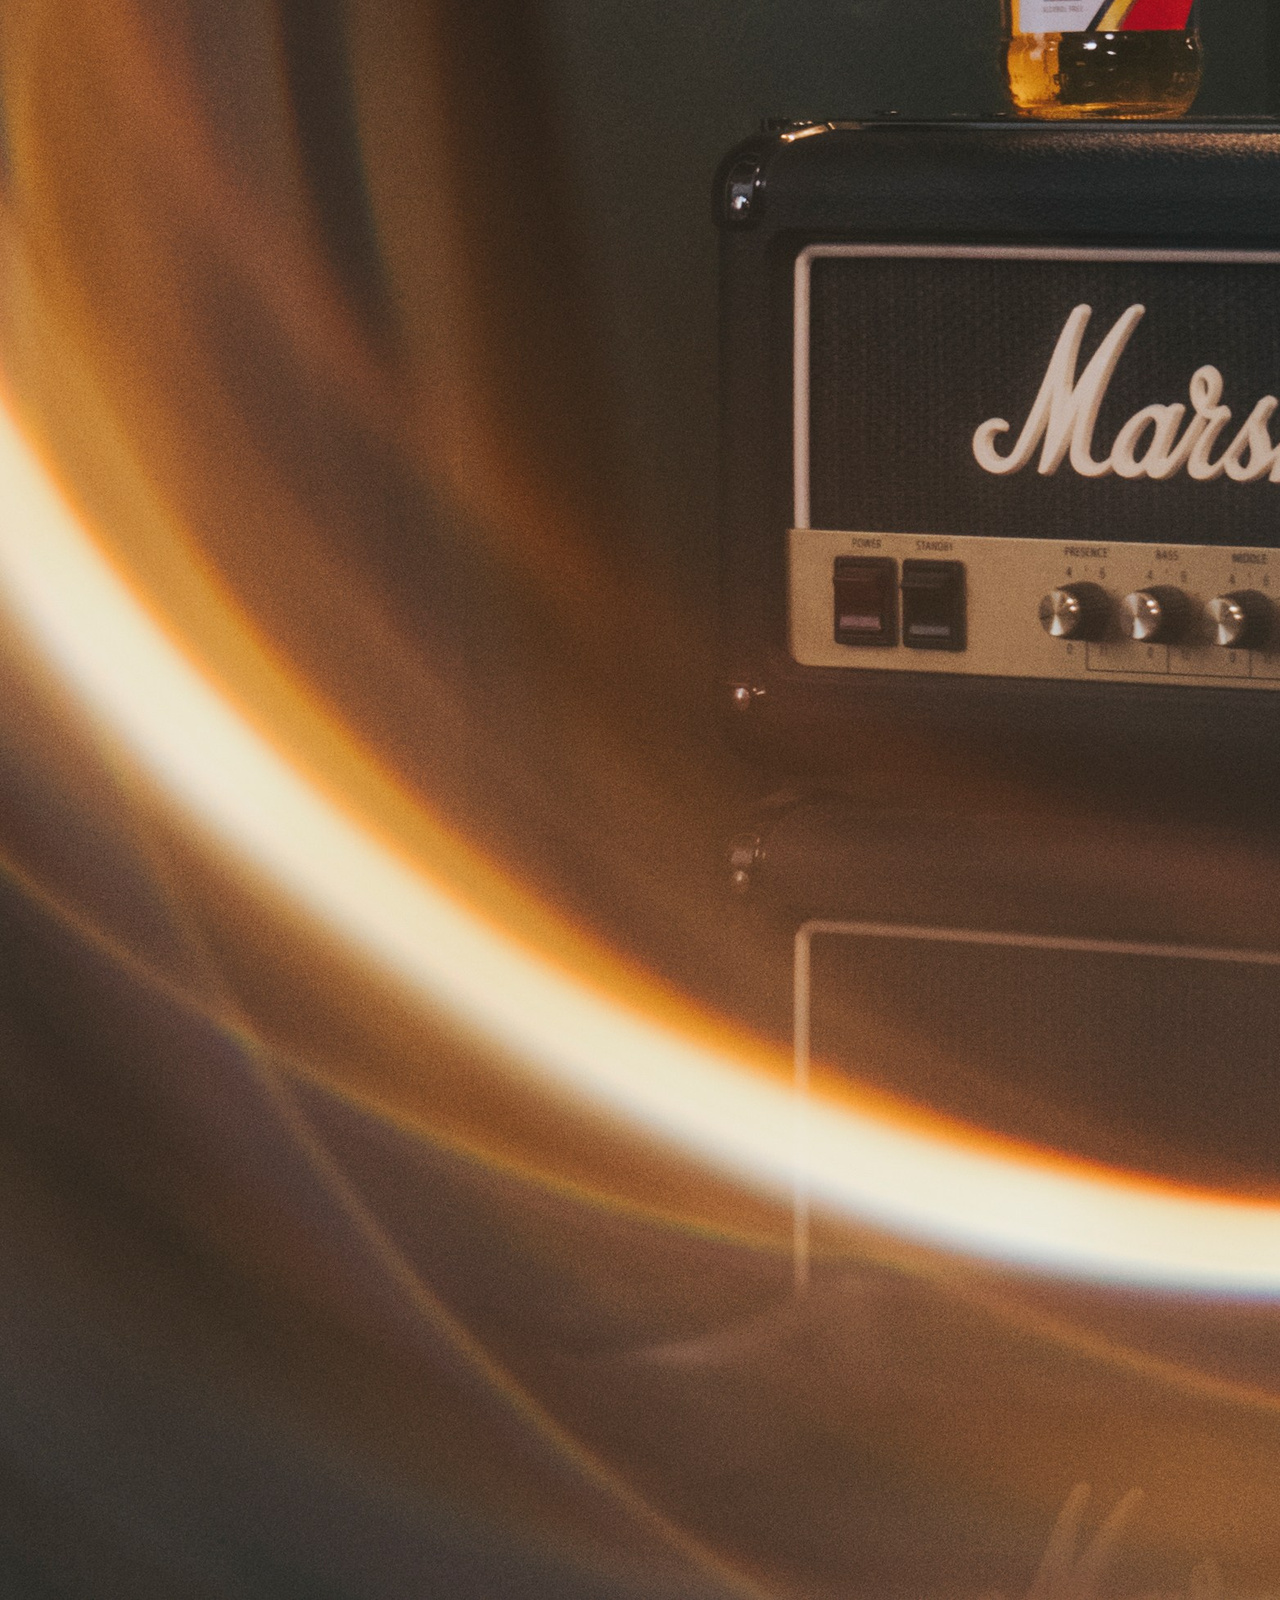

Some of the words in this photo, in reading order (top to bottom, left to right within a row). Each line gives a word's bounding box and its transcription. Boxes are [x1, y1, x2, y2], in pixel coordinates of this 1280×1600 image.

[852, 538, 882, 549] POWER
[1064, 546, 1107, 558] PRESENCE
[1155, 549, 1179, 561] BASS
